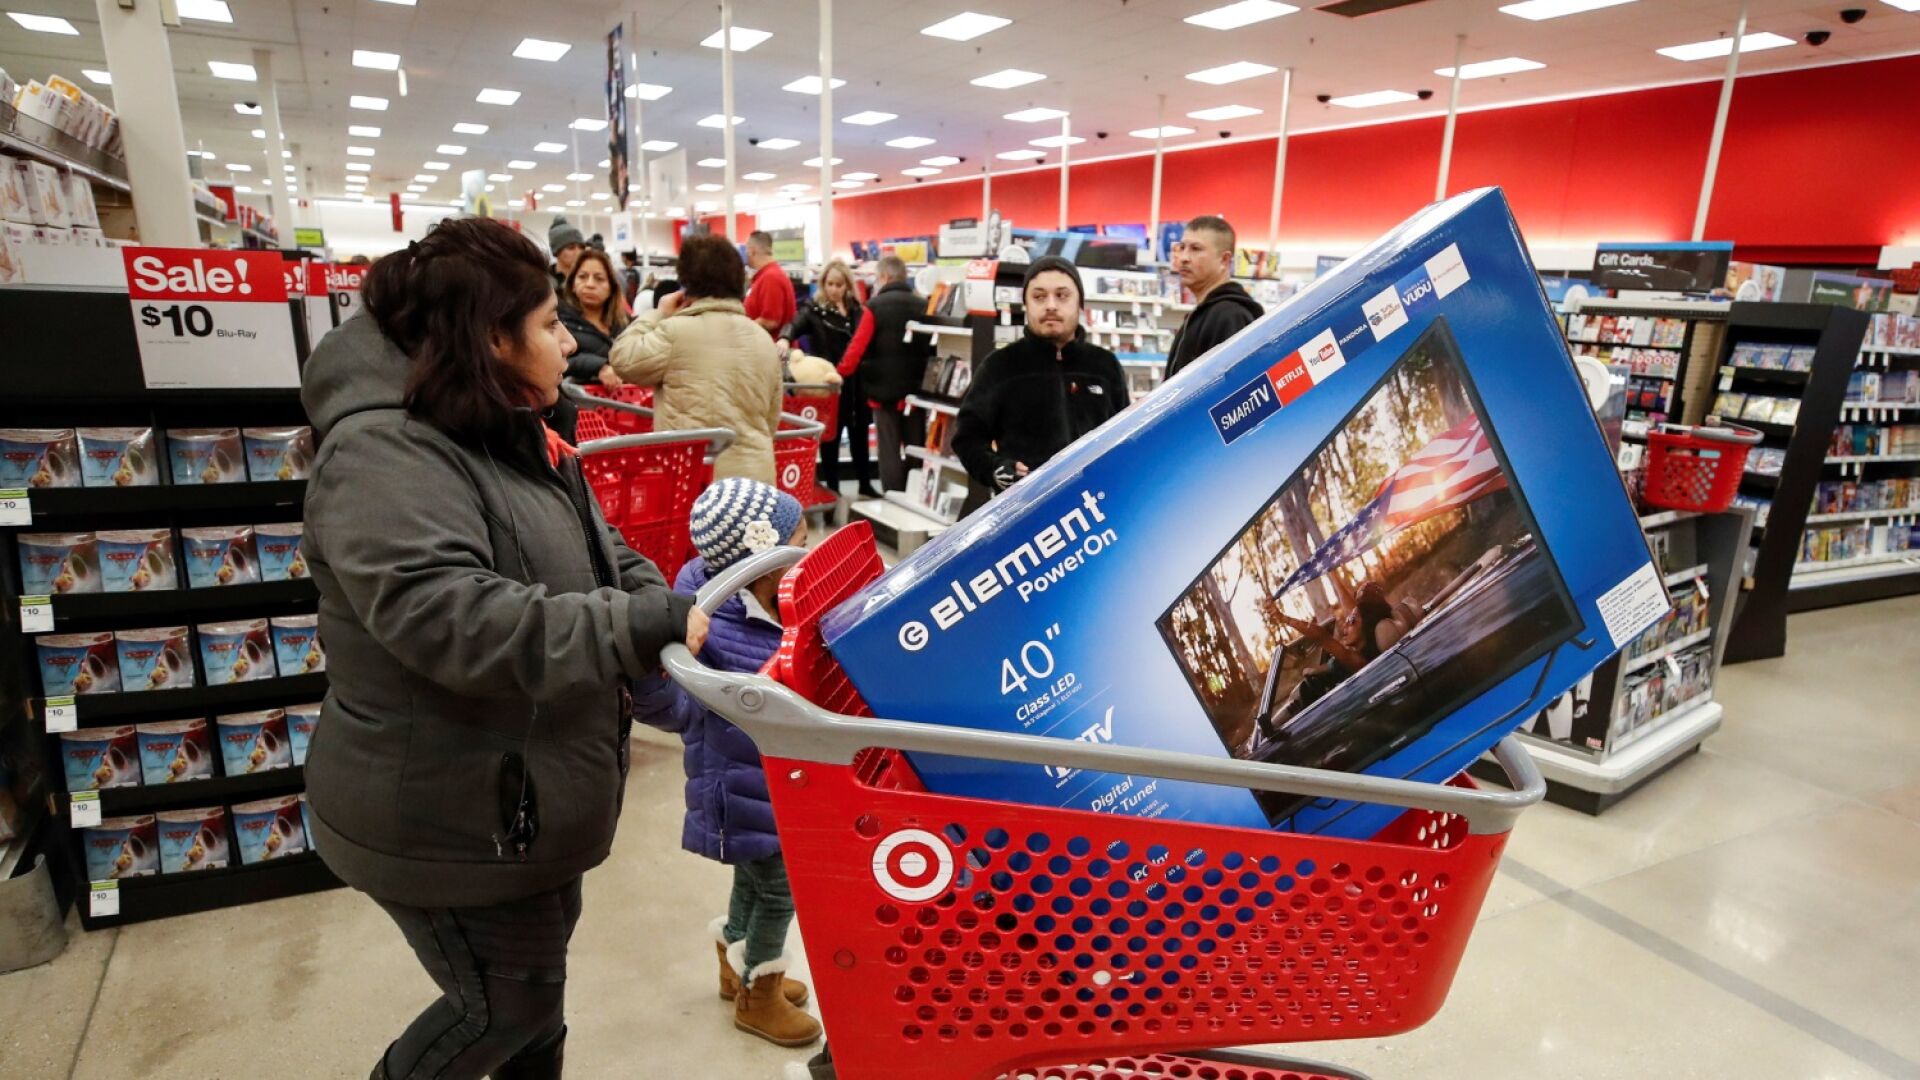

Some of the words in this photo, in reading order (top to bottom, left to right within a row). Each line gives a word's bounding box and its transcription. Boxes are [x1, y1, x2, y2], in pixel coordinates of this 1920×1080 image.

[133, 255, 252, 294] Sale!
[1598, 253, 1619, 265] Gift
[1620, 253, 1655, 266] Cards
[1402, 280, 1432, 307] VUDU
[141, 304, 214, 337] $10
[216, 328, 257, 340] Blu-Ray
[1338, 323, 1368, 346] PANDORA
[1275, 365, 1305, 391] NETFLIX
[1016, 528, 1118, 603] PowerOn
[1016, 692, 1050, 721] Class
[1050, 672, 1076, 697] LED
[1091, 775, 1134, 812] Digital
[1120, 780, 1158, 811] Tuner
